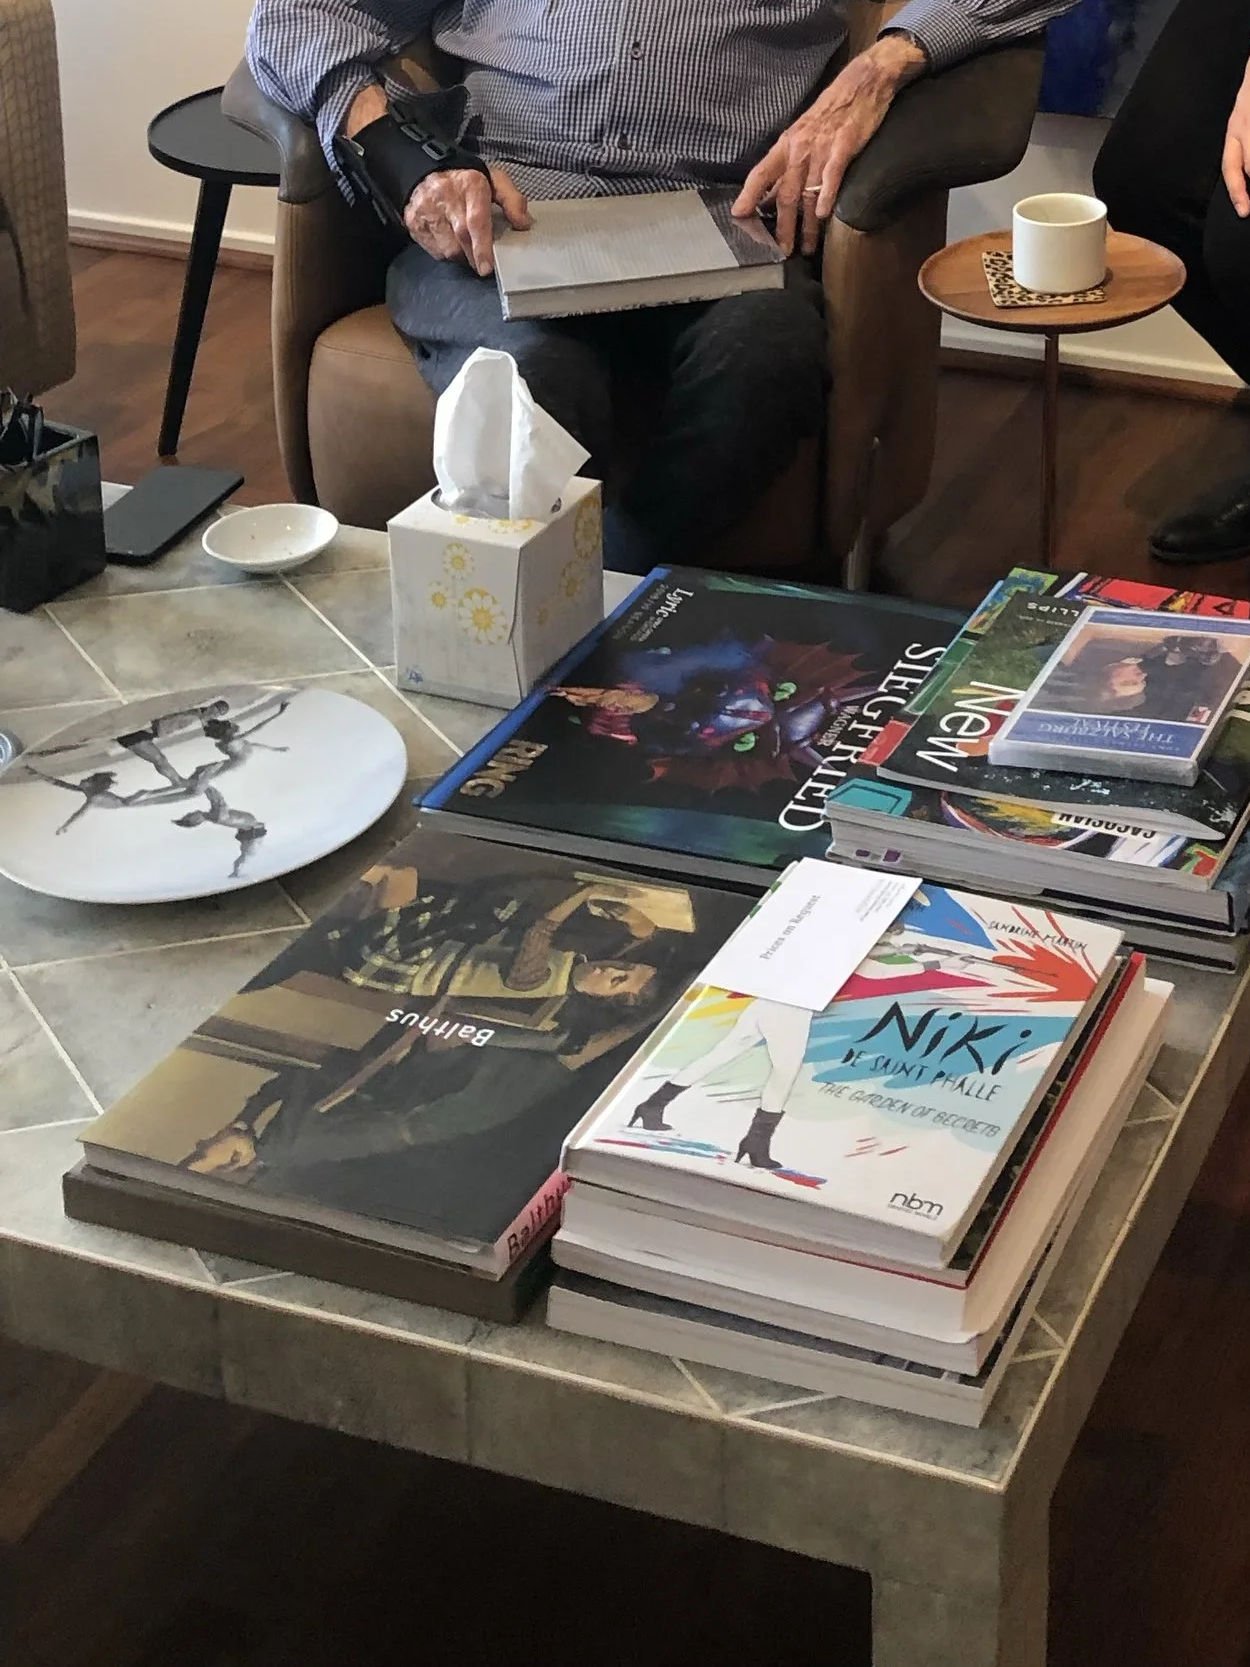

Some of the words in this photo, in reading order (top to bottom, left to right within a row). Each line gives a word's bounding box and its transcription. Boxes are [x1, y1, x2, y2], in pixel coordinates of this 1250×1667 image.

[656, 588, 694, 618] Lyric
[779, 643, 947, 832] SIEGFRIED
[818, 705, 859, 746] WAGNER
[916, 681, 1027, 772] New
[460, 739, 549, 798] RING
[759, 937, 785, 960] Prices
[783, 923, 797, 936] on
[794, 894, 821, 924] Request
[385, 1008, 496, 1047] Balthus
[842, 1048, 867, 1067] DE
[870, 1055, 929, 1081] SAINT
[930, 1070, 1001, 1102] PHALLE
[819, 1082, 848, 1099] THE
[848, 1089, 909, 1117] GARDEN
[911, 1105, 933, 1119] OF
[932, 1111, 1001, 1137] SECRETS
[889, 1192, 944, 1216] nbm
